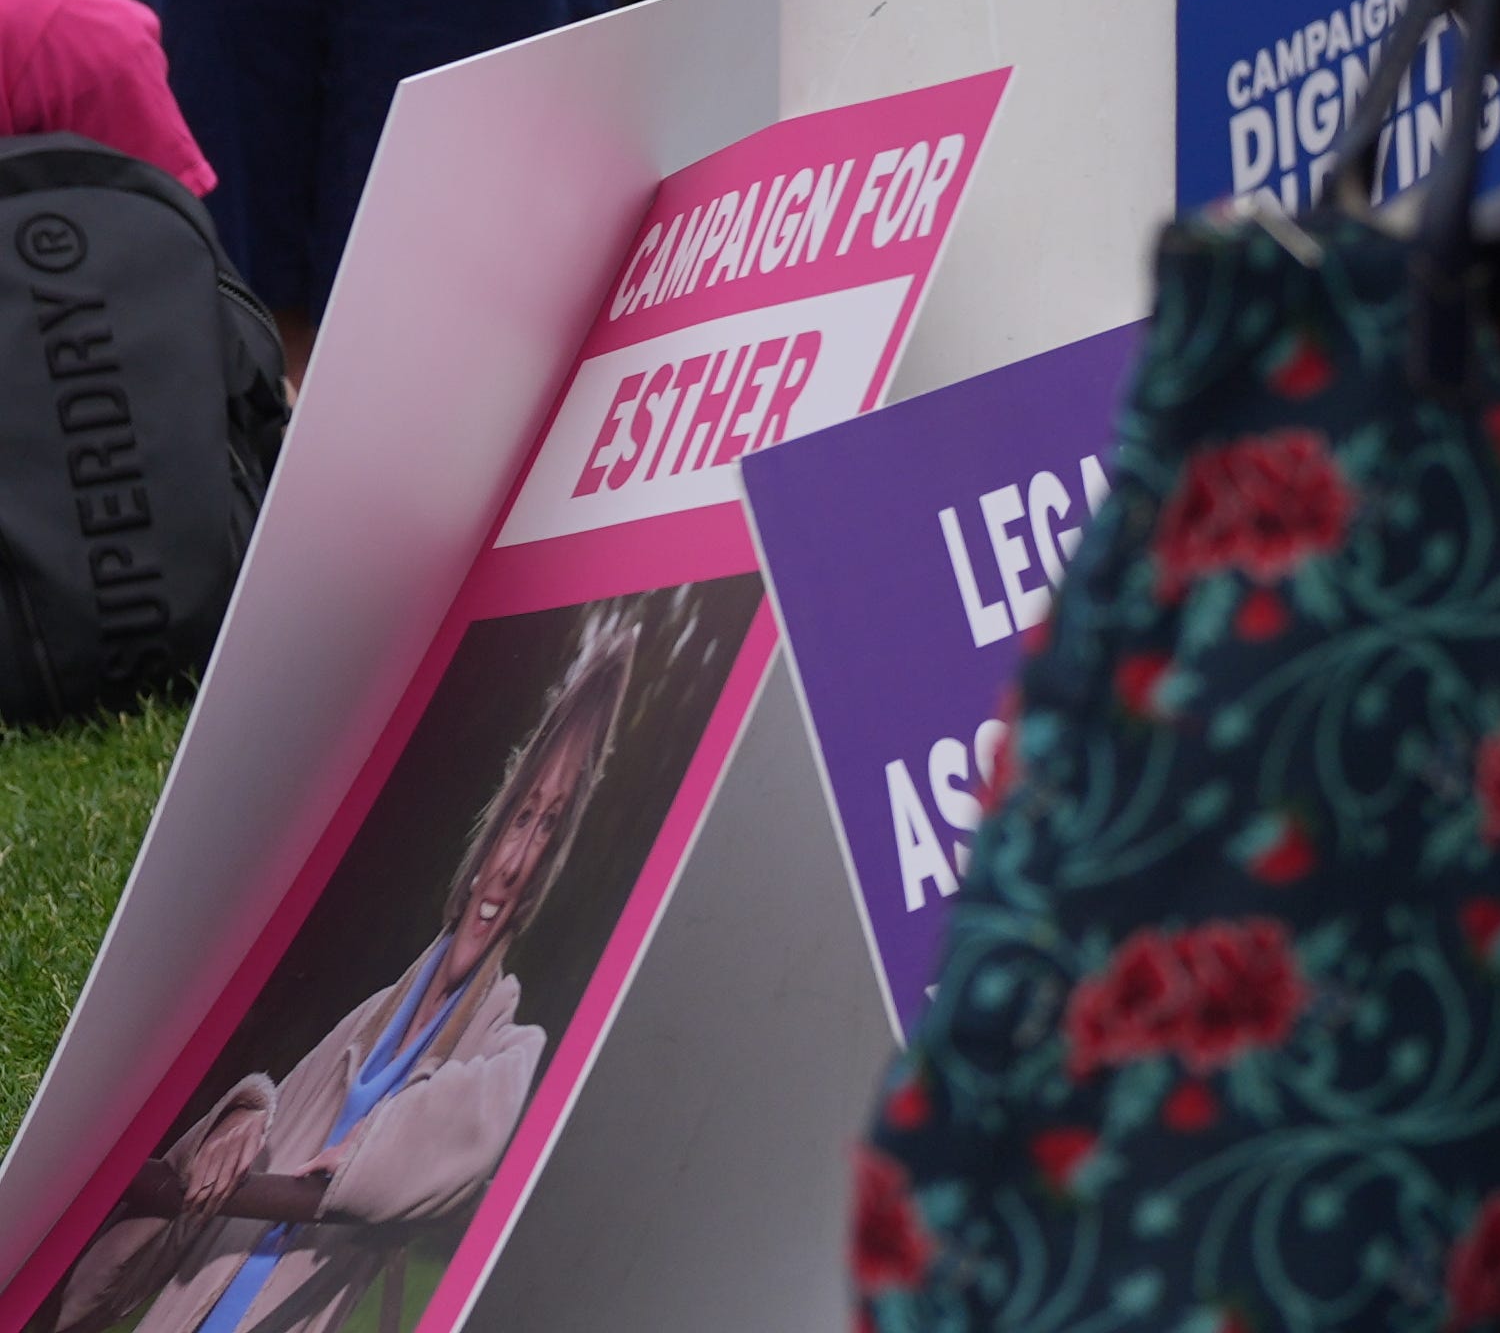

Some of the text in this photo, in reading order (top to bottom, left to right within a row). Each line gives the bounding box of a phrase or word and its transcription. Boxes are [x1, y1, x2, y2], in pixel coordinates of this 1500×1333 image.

[609, 133, 966, 323] CAMPAIGN FOR
[571, 330, 822, 500] ESTHER
